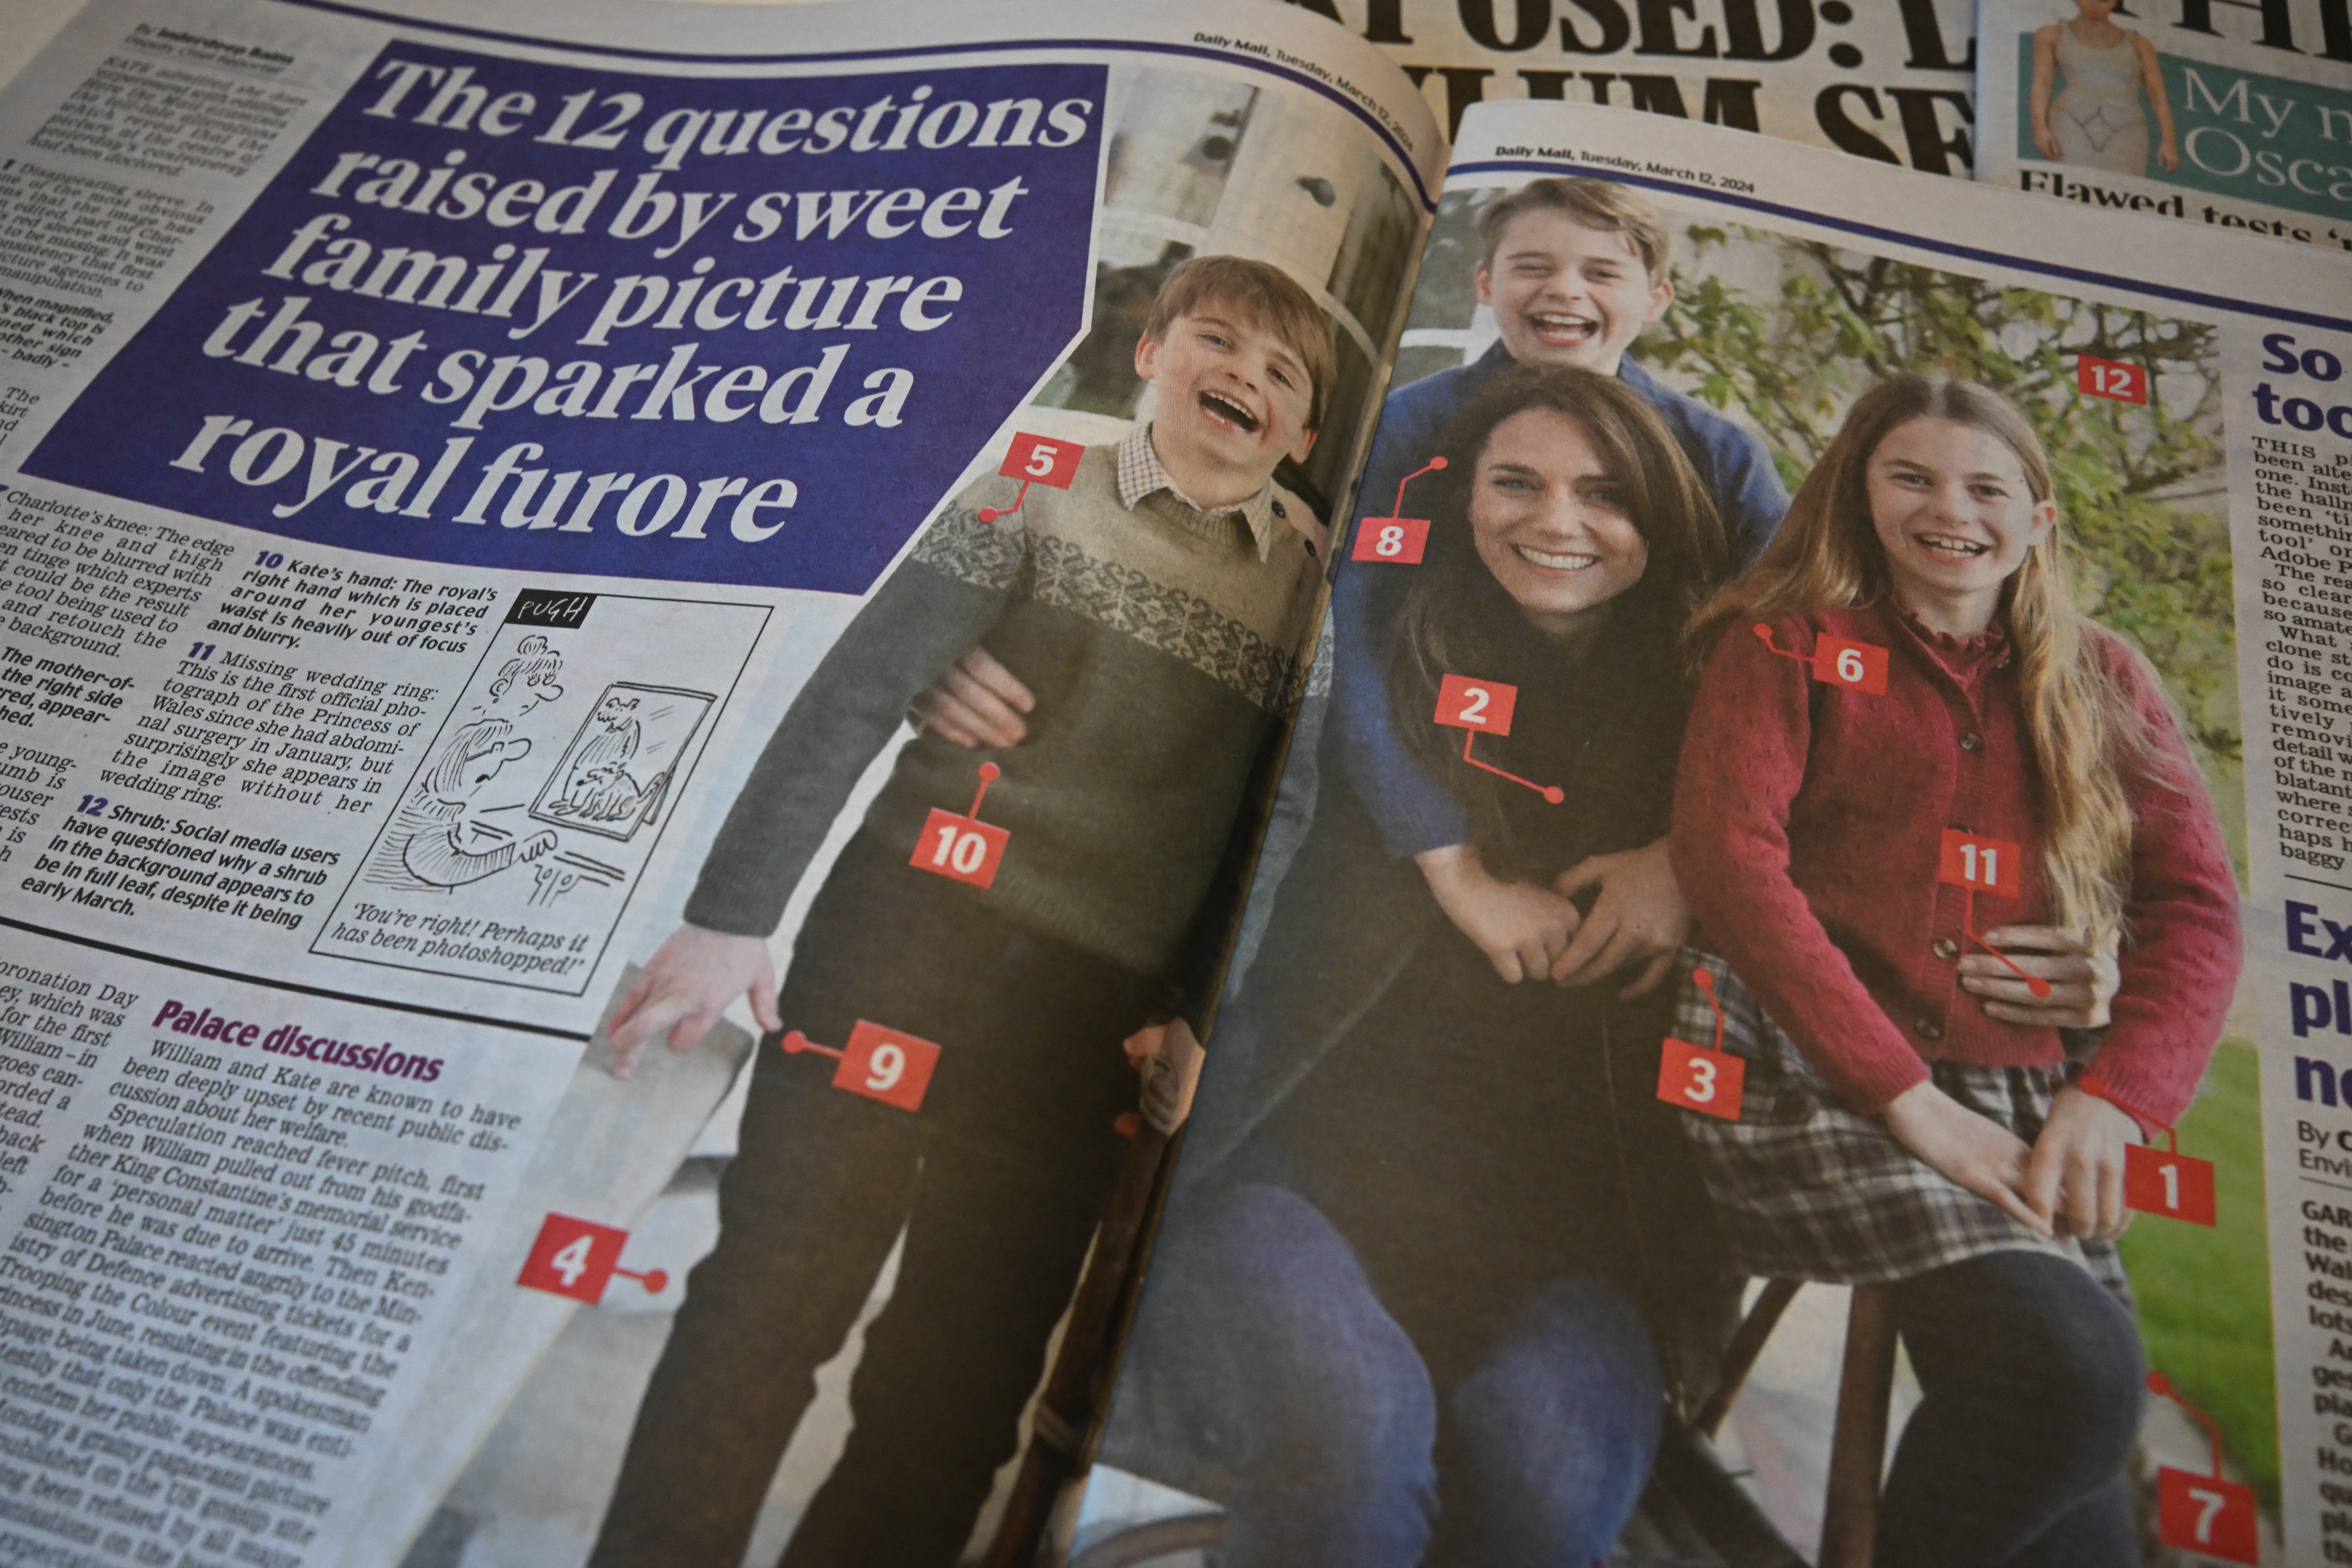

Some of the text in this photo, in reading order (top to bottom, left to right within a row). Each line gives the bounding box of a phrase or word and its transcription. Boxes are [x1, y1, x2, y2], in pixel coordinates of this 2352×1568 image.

[362, 59, 537, 136] The
[533, 89, 645, 151] 12
[642, 84, 1094, 172] questions
[1193, 32, 1415, 152] Daily Mail, Tuesday, March 12, 2024
[1495, 145, 1756, 193] Daily Mail, Tuesday, March 12, 2024
[309, 149, 1029, 259] raised by sweet
[261, 213, 964, 346] family picture
[202, 296, 915, 430] that sparked a
[2091, 365, 2132, 396] 12
[2262, 332, 2343, 383] So
[1025, 444, 1058, 476] 5
[2251, 435, 2317, 459] THIS
[2254, 450, 2305, 472] been
[169, 415, 798, 543] royal furore
[2255, 467, 2298, 487] one.
[6, 491, 235, 556] Charlotte's knee: The edge
[2257, 496, 2312, 520] been
[8, 507, 223, 571] her knee and thigh
[1376, 526, 1404, 556] 8
[2258, 528, 2314, 550] tool'
[2259, 545, 2332, 572] Adobe
[242, 570, 489, 618] right hand which is placed
[255, 551, 498, 601] 10 Kate's hand: The royal's
[220, 602, 467, 653] waist is heavily out of focus
[231, 587, 477, 635] around her youngest's
[517, 595, 589, 623] PUGH
[206, 620, 300, 649] and blurry.
[2265, 640, 2322, 661] clone
[2278, 625, 2338, 648] What
[177, 660, 426, 717] This is the first official pho-
[188, 642, 439, 702] 11 Missing wedding ring:
[1837, 648, 1864, 682] 6
[2267, 671, 2333, 696] image
[153, 695, 404, 755] Wales since she had abdomi-
[163, 678, 421, 737] tograph of the Princess of
[1459, 688, 1489, 724] 2
[2269, 703, 2335, 730] tively
[136, 715, 394, 775] nal surgery in January, but
[2272, 738, 2333, 762] detail
[2276, 791, 2342, 815] where
[62, 815, 327, 885] have questioned why a shrub
[77, 794, 340, 865] 12 Shrub: Social media users
[933, 826, 986, 873] 10
[48, 835, 315, 906] in the background appears to
[1960, 844, 1996, 885] 11
[2279, 841, 2345, 871] baggy
[21, 877, 134, 916] early March.
[34, 854, 303, 930] be in full leaf, despite it being
[330, 922, 369, 943] has
[370, 929, 418, 952] been
[418, 914, 481, 937] right!
[479, 922, 565, 950] Perhaps
[568, 934, 589, 953] it
[152, 999, 445, 1083] Palace discussions
[150, 1039, 521, 1130] William and Kate are known to have
[866, 1043, 905, 1090] 9
[1684, 1058, 1716, 1102] 3
[2297, 1120, 2331, 1149] By
[2159, 1164, 2178, 1209] 1
[552, 1235, 593, 1286] 4
[2189, 1487, 2224, 1543] 7
